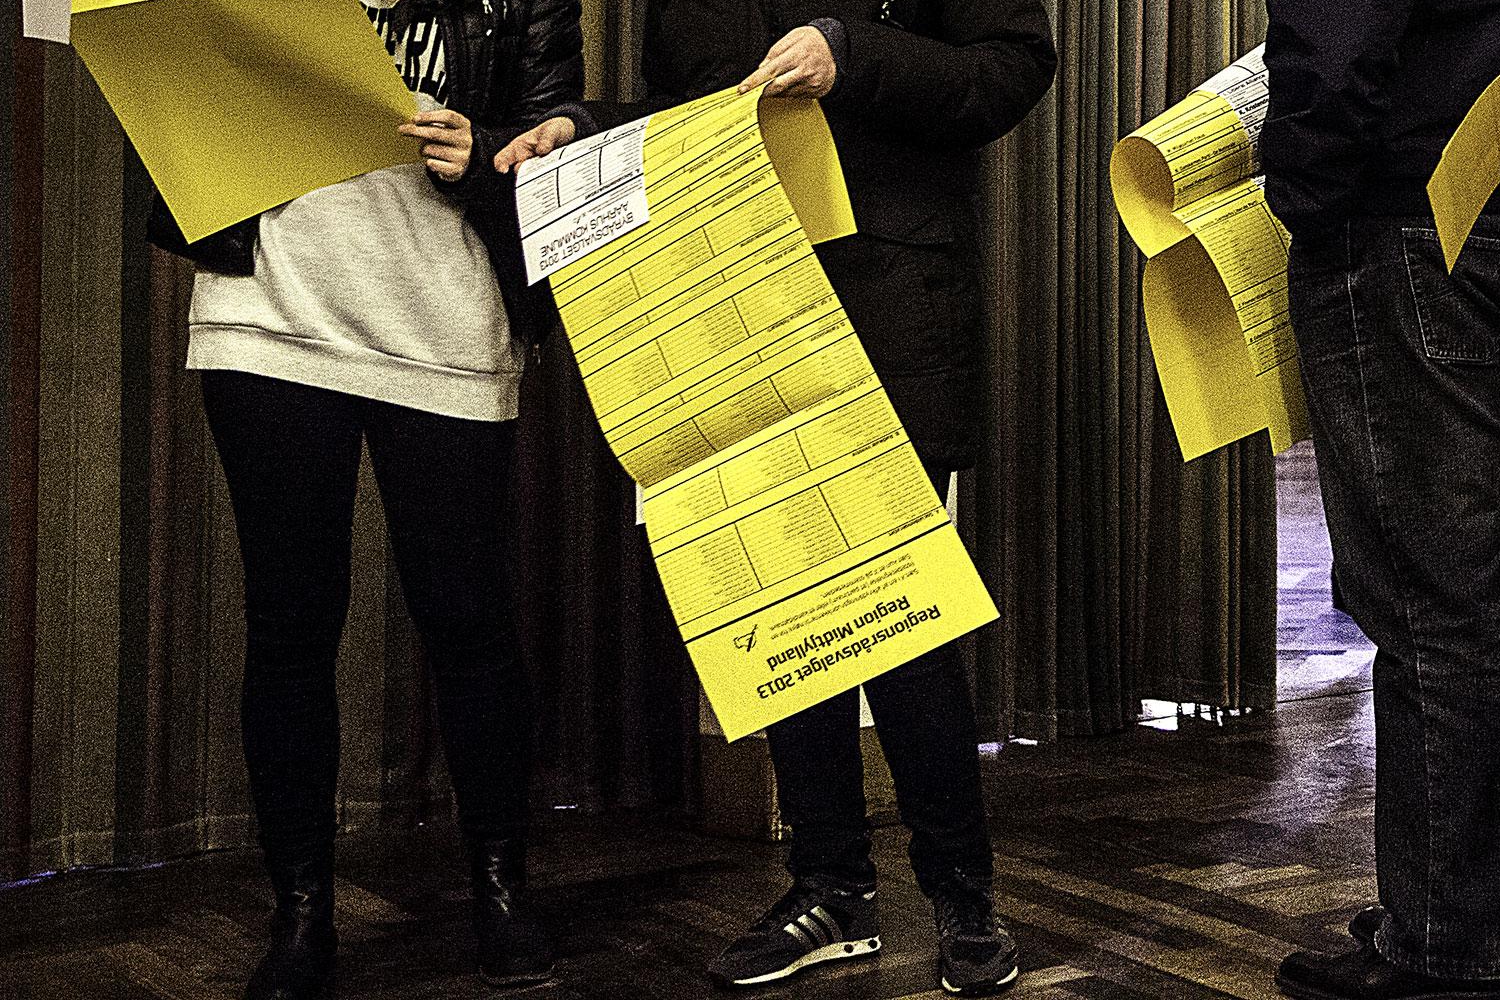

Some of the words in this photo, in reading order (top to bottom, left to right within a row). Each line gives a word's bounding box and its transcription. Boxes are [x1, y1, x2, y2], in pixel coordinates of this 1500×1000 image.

[590, 203, 629, 230] AARHUS
[541, 226, 588, 257] KOMMUNE
[562, 212, 634, 260] BYRÅDSVALGET
[854, 596, 911, 628] Region
[767, 623, 855, 671] Midtjylland
[794, 605, 942, 682] Regionsrådsvalget
[757, 673, 796, 699] 2013
